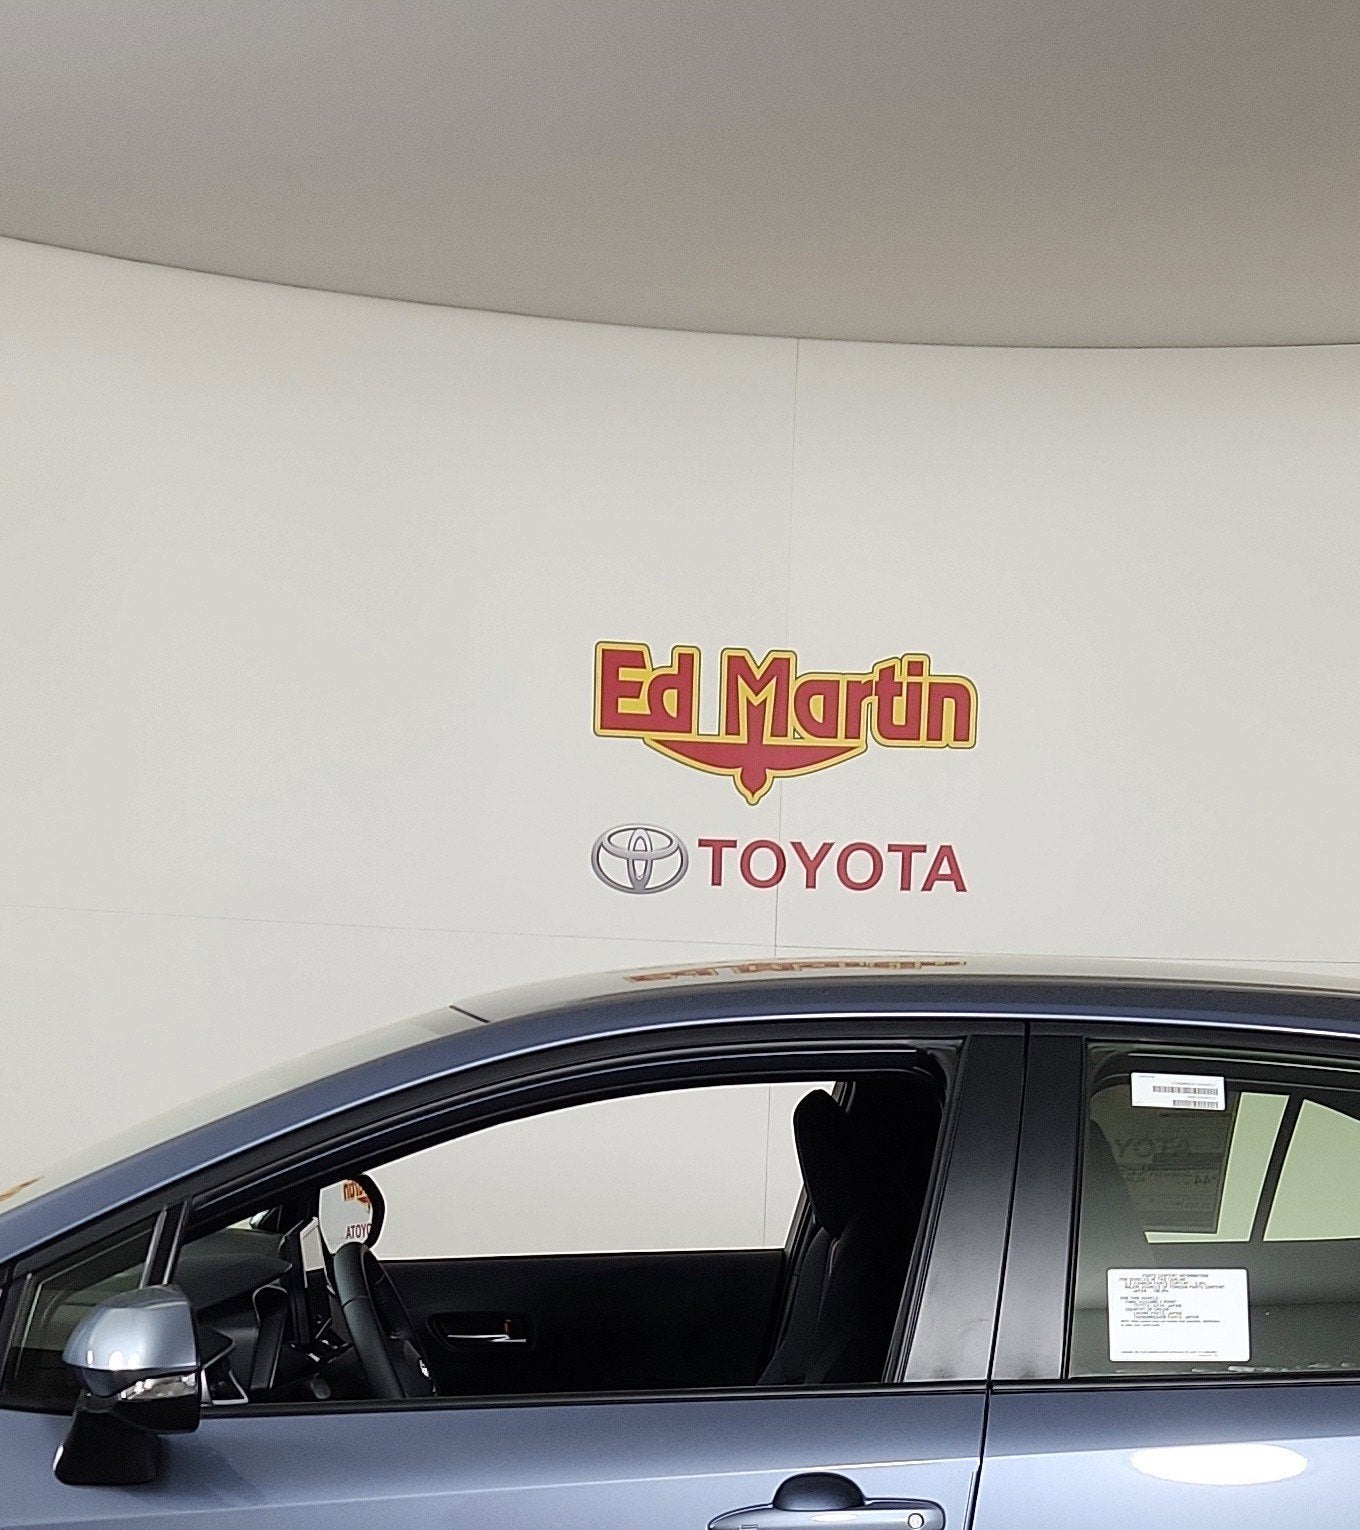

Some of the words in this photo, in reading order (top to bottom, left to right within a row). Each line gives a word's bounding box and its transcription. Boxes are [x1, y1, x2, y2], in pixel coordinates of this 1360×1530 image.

[597, 645, 694, 736] Ed
[723, 652, 974, 744] Martin
[696, 838, 968, 893] TOYOTA
